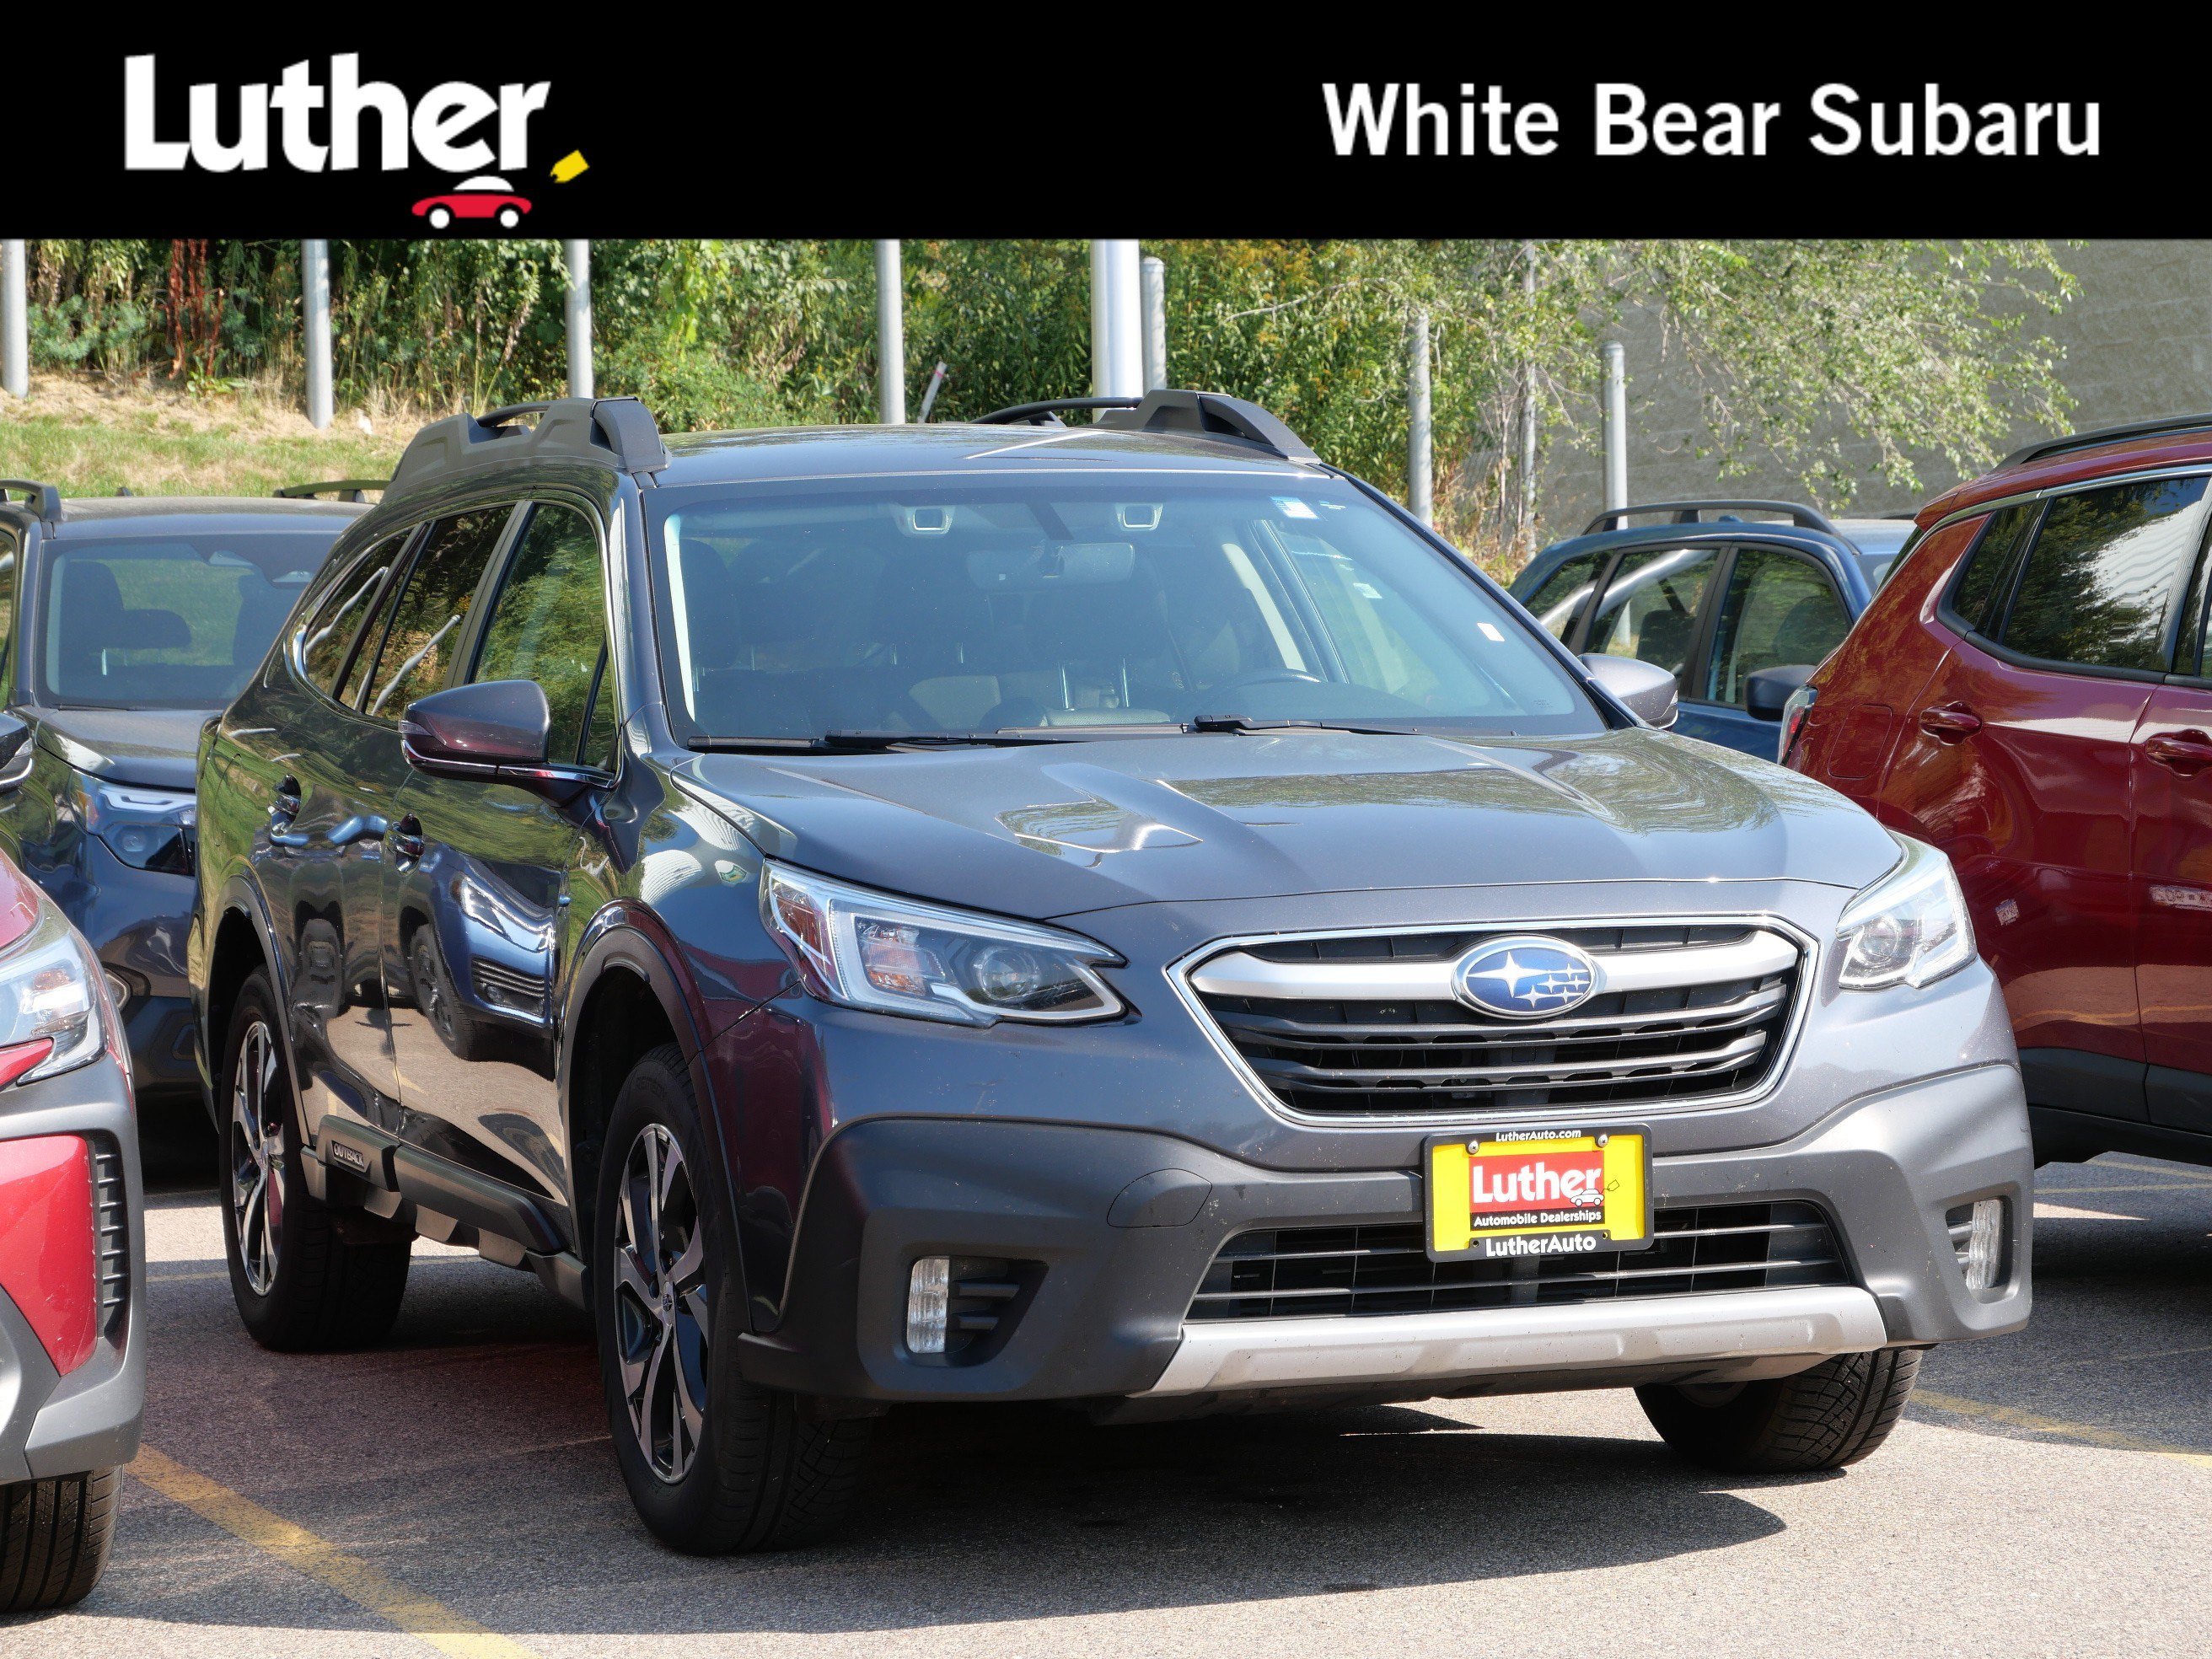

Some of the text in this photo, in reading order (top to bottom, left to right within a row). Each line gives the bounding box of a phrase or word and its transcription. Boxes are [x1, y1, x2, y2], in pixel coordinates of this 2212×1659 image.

[1495, 1129, 1581, 1142] LutherAuto.com
[333, 1143, 364, 1167] OUTBACK
[1472, 1162, 1603, 1204] Luther
[1474, 1211, 1602, 1227] Automobile Dealerships
[1485, 1234, 1597, 1258] LutherAuto
